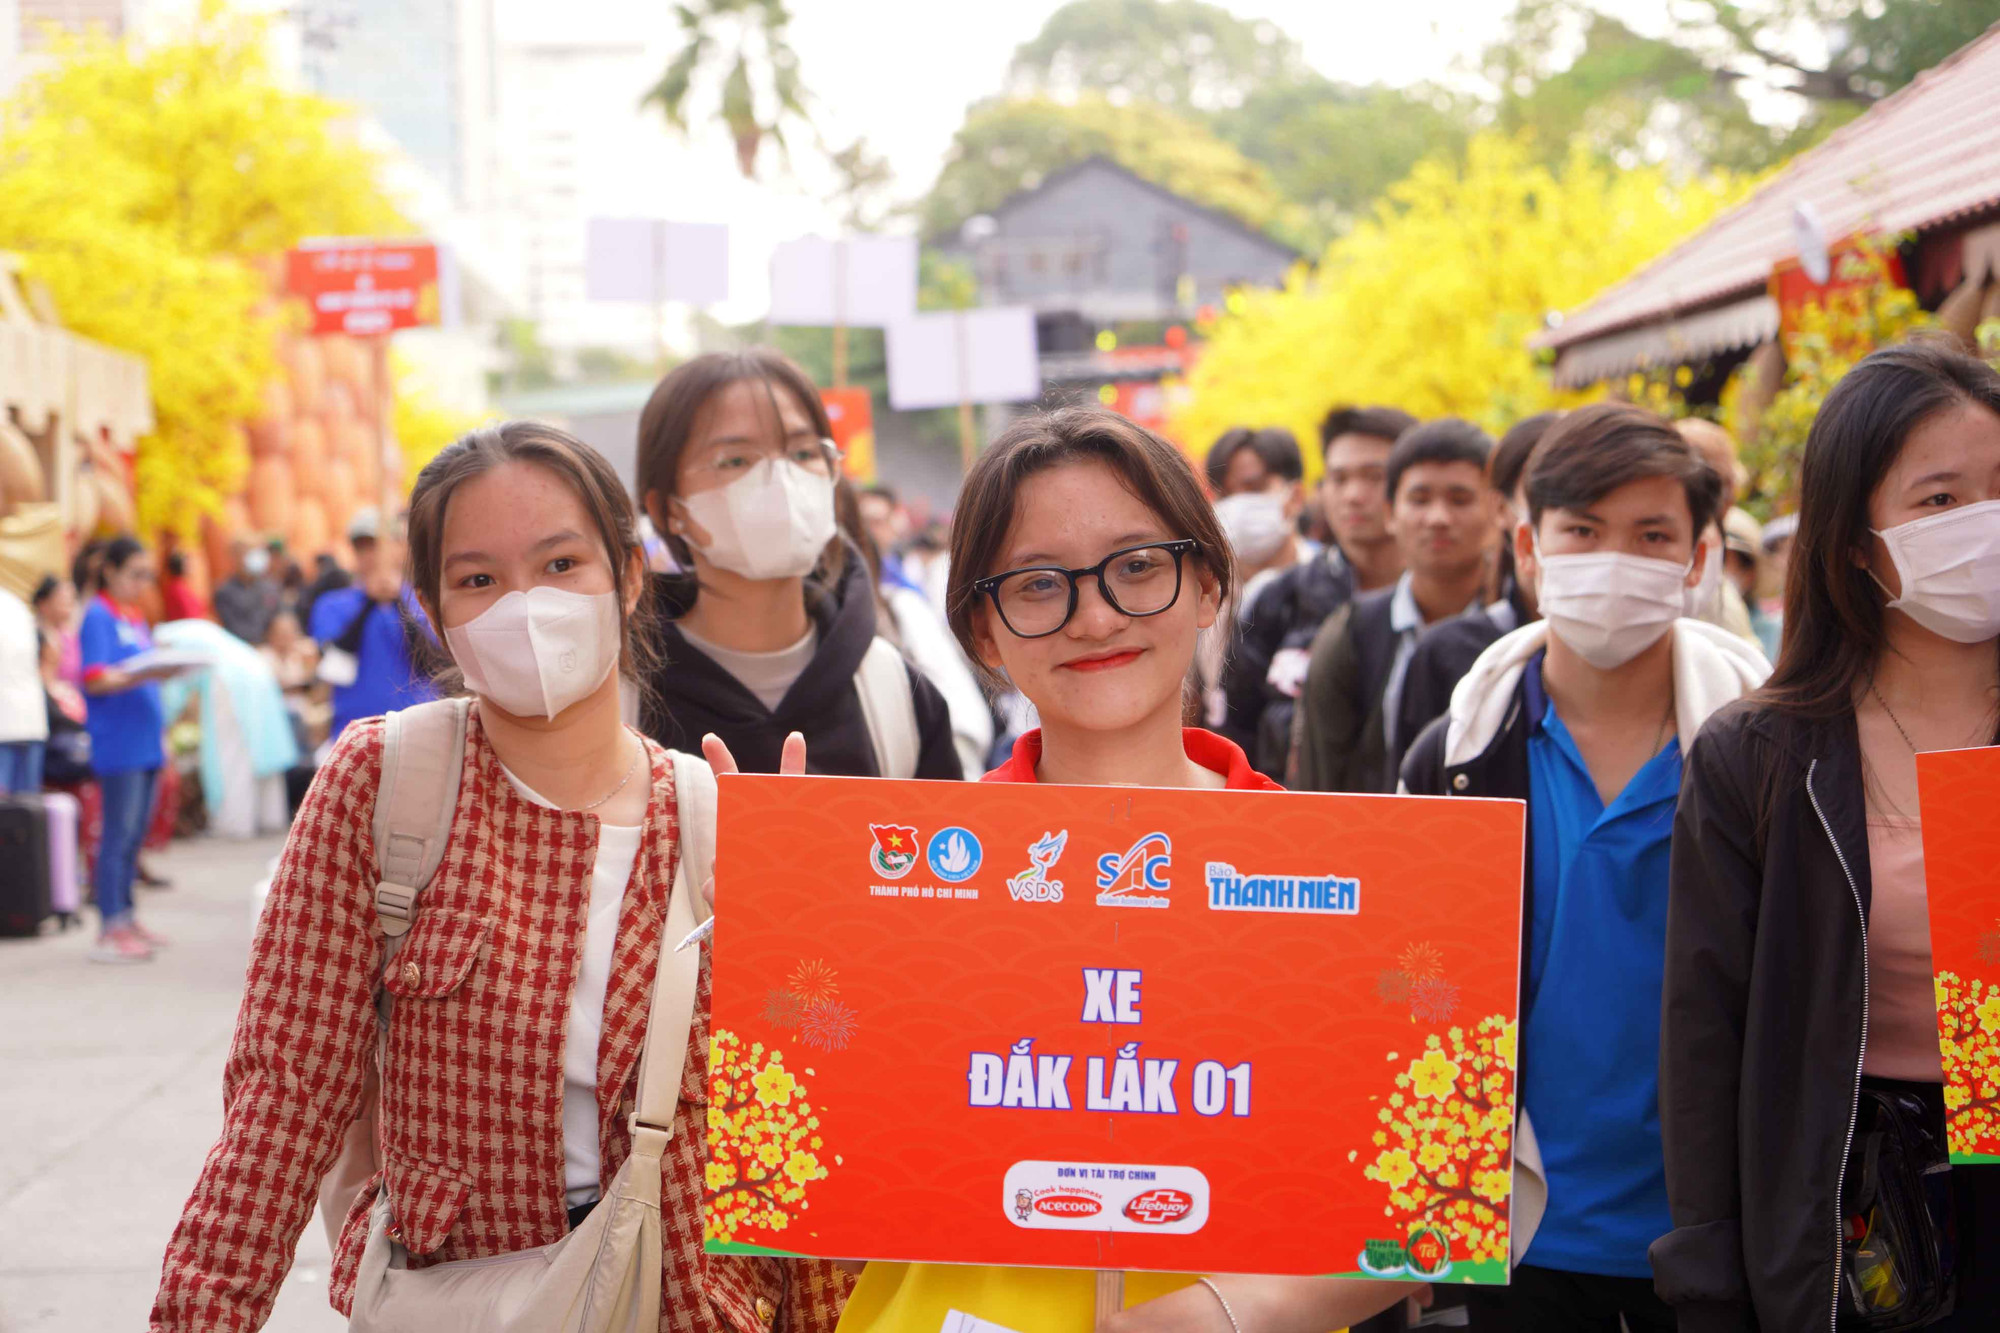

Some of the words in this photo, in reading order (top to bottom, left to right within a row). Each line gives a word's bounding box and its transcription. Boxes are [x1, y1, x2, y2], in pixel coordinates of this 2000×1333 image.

[955, 888, 979, 899] MINH
[1009, 881, 1062, 900] VSDS
[1210, 877, 1293, 907] THANH
[1298, 879, 1355, 910] NIÊN
[1081, 968, 1142, 1024] XE
[967, 1038, 1073, 1110] ĐẮK
[1086, 1042, 1180, 1114] LẮK
[1192, 1060, 1252, 1117] 01
[1033, 1185, 1056, 1197] Cook
[1059, 1185, 1103, 1199] happiness
[1130, 1199, 1189, 1213] Lifebuoy
